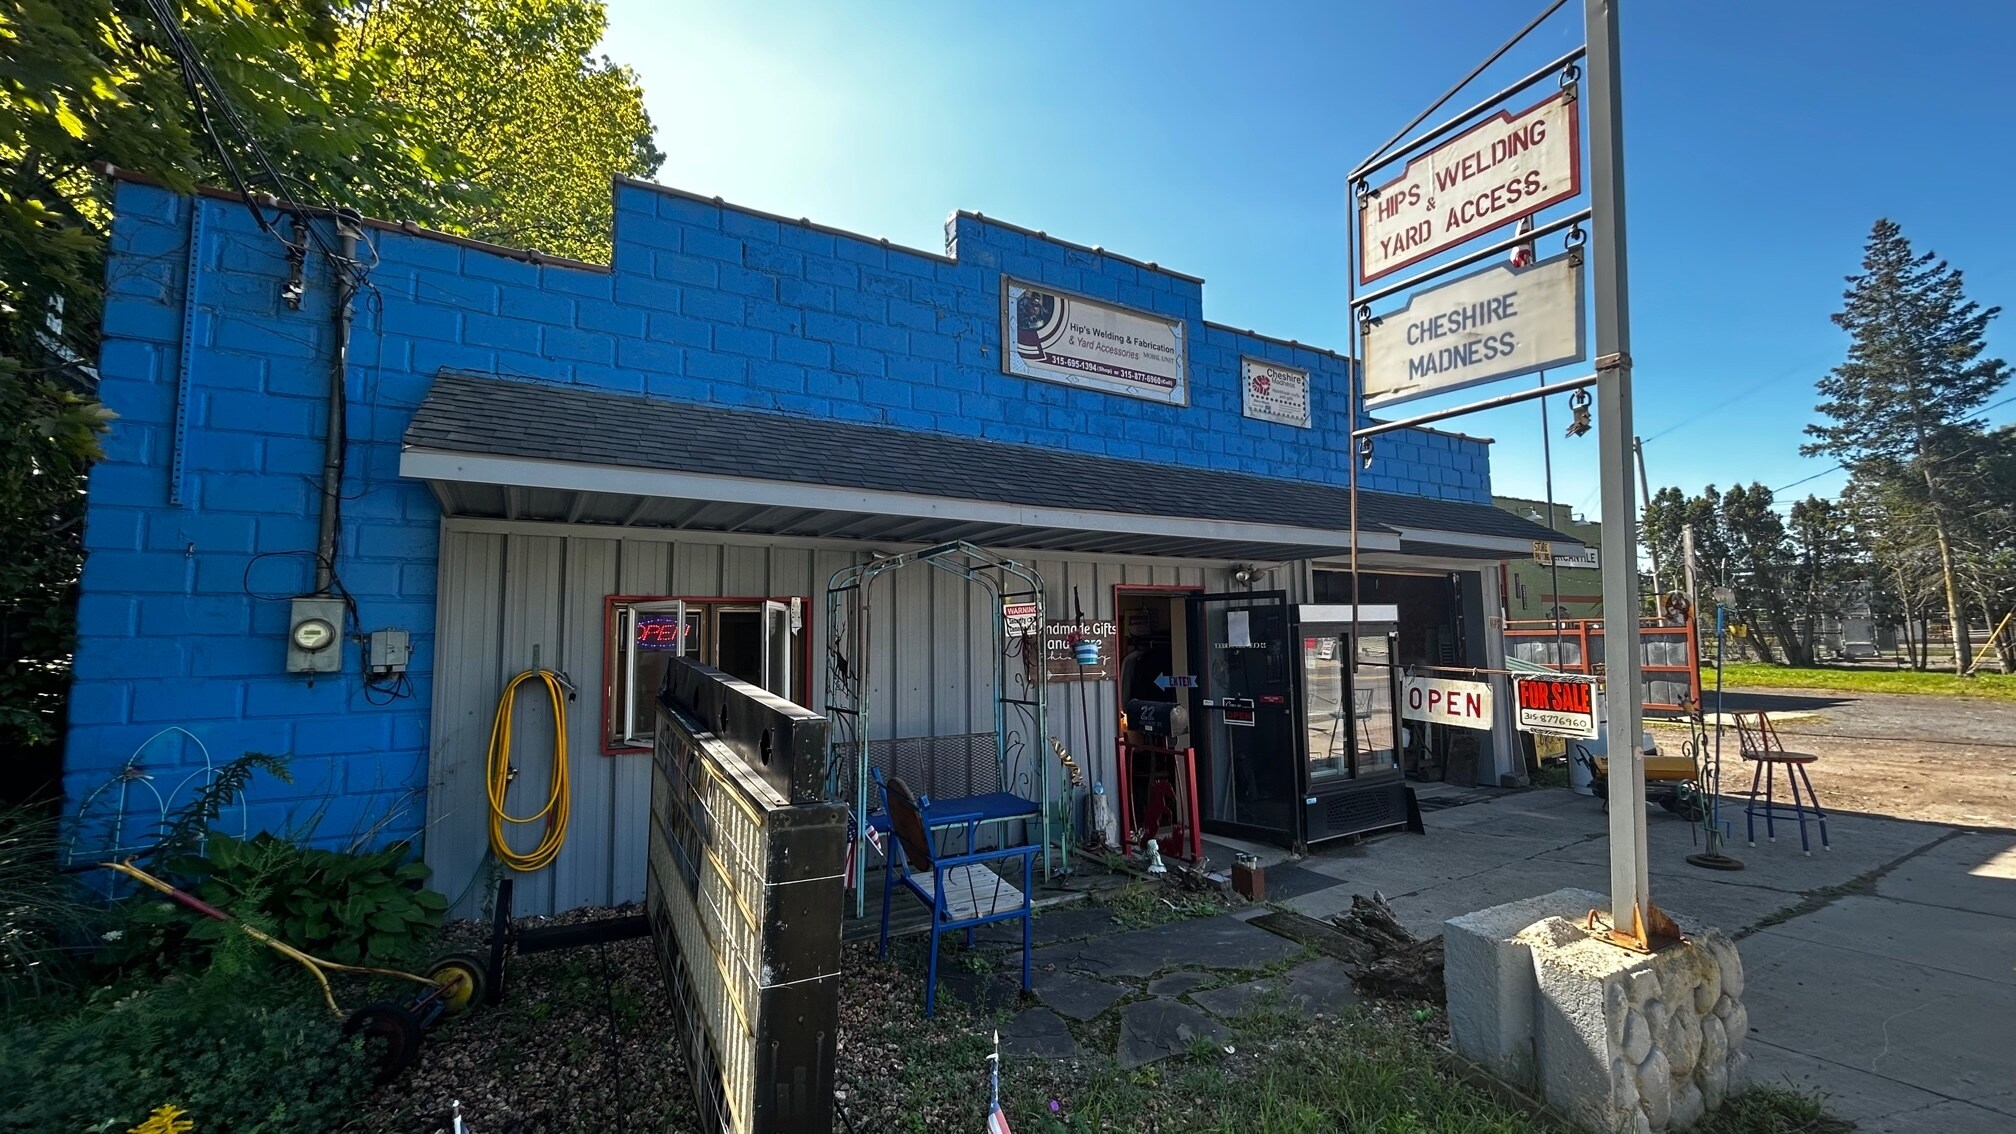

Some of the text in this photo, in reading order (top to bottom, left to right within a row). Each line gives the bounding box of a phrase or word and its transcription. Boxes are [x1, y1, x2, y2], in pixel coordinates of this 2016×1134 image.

[1378, 119, 1547, 223] HIPS WELDING
[1380, 169, 1548, 260] YARD ACCESS.
[1426, 197, 1436, 212] &
[1406, 291, 1518, 346] CHESHIRE
[1068, 335, 1139, 360] & Yard Accessories
[1070, 322, 1175, 354] Hip's Welding & Fabrication
[1408, 331, 1515, 381] MADNESS
[1266, 368, 1301, 384] Cheshire
[1092, 622, 1117, 638] Gifts
[1169, 676, 1192, 687] ENTER
[1520, 680, 1591, 713] FOR SALE
[1140, 704, 1155, 721] 22
[1408, 686, 1482, 719] OPEN
